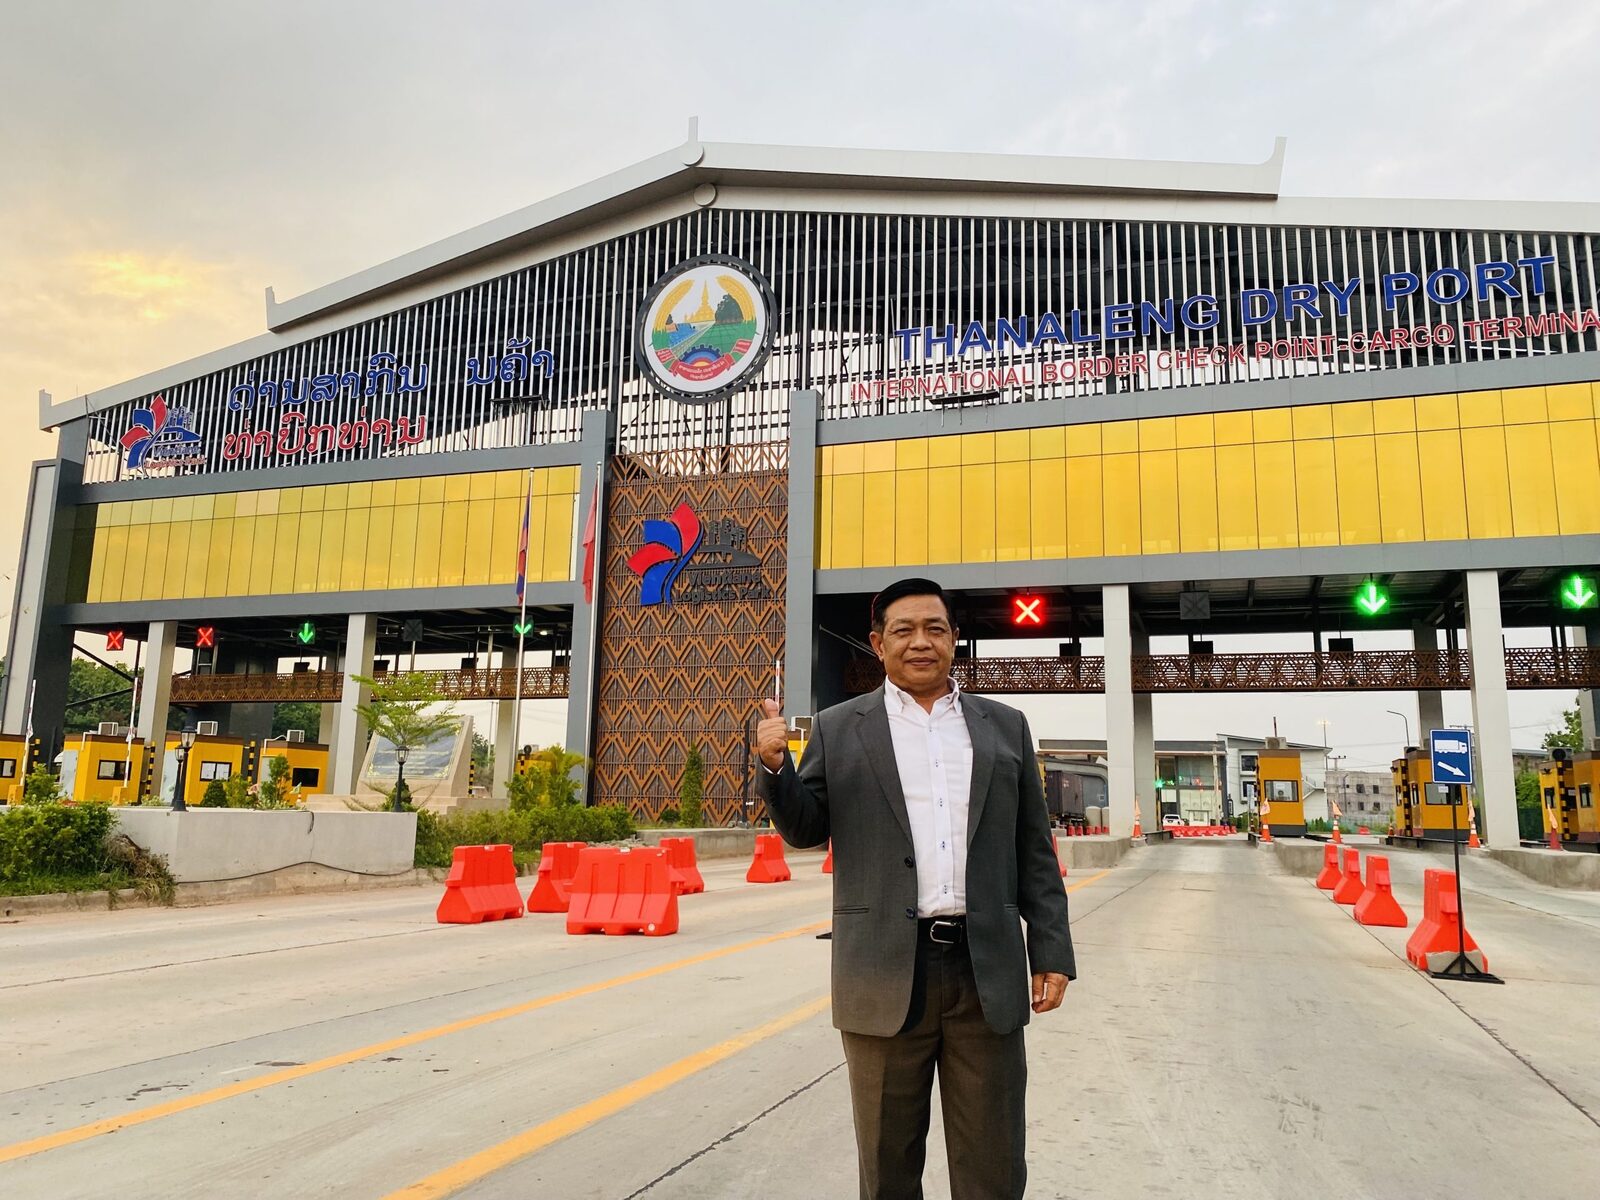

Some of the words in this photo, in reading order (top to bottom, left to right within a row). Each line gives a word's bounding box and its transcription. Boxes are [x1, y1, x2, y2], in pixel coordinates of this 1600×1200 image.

[895, 294, 1220, 361] THANALENG
[1241, 278, 1361, 326] DRY
[1383, 256, 1555, 311] PORT
[850, 366, 1034, 400] INTERNATIONAL
[1042, 353, 1149, 384] BORDER
[1157, 344, 1247, 371] CHECK
[674, 587, 736, 605] Logistics
[739, 586, 771, 600] Park
[687, 570, 762, 586] Vientiane
